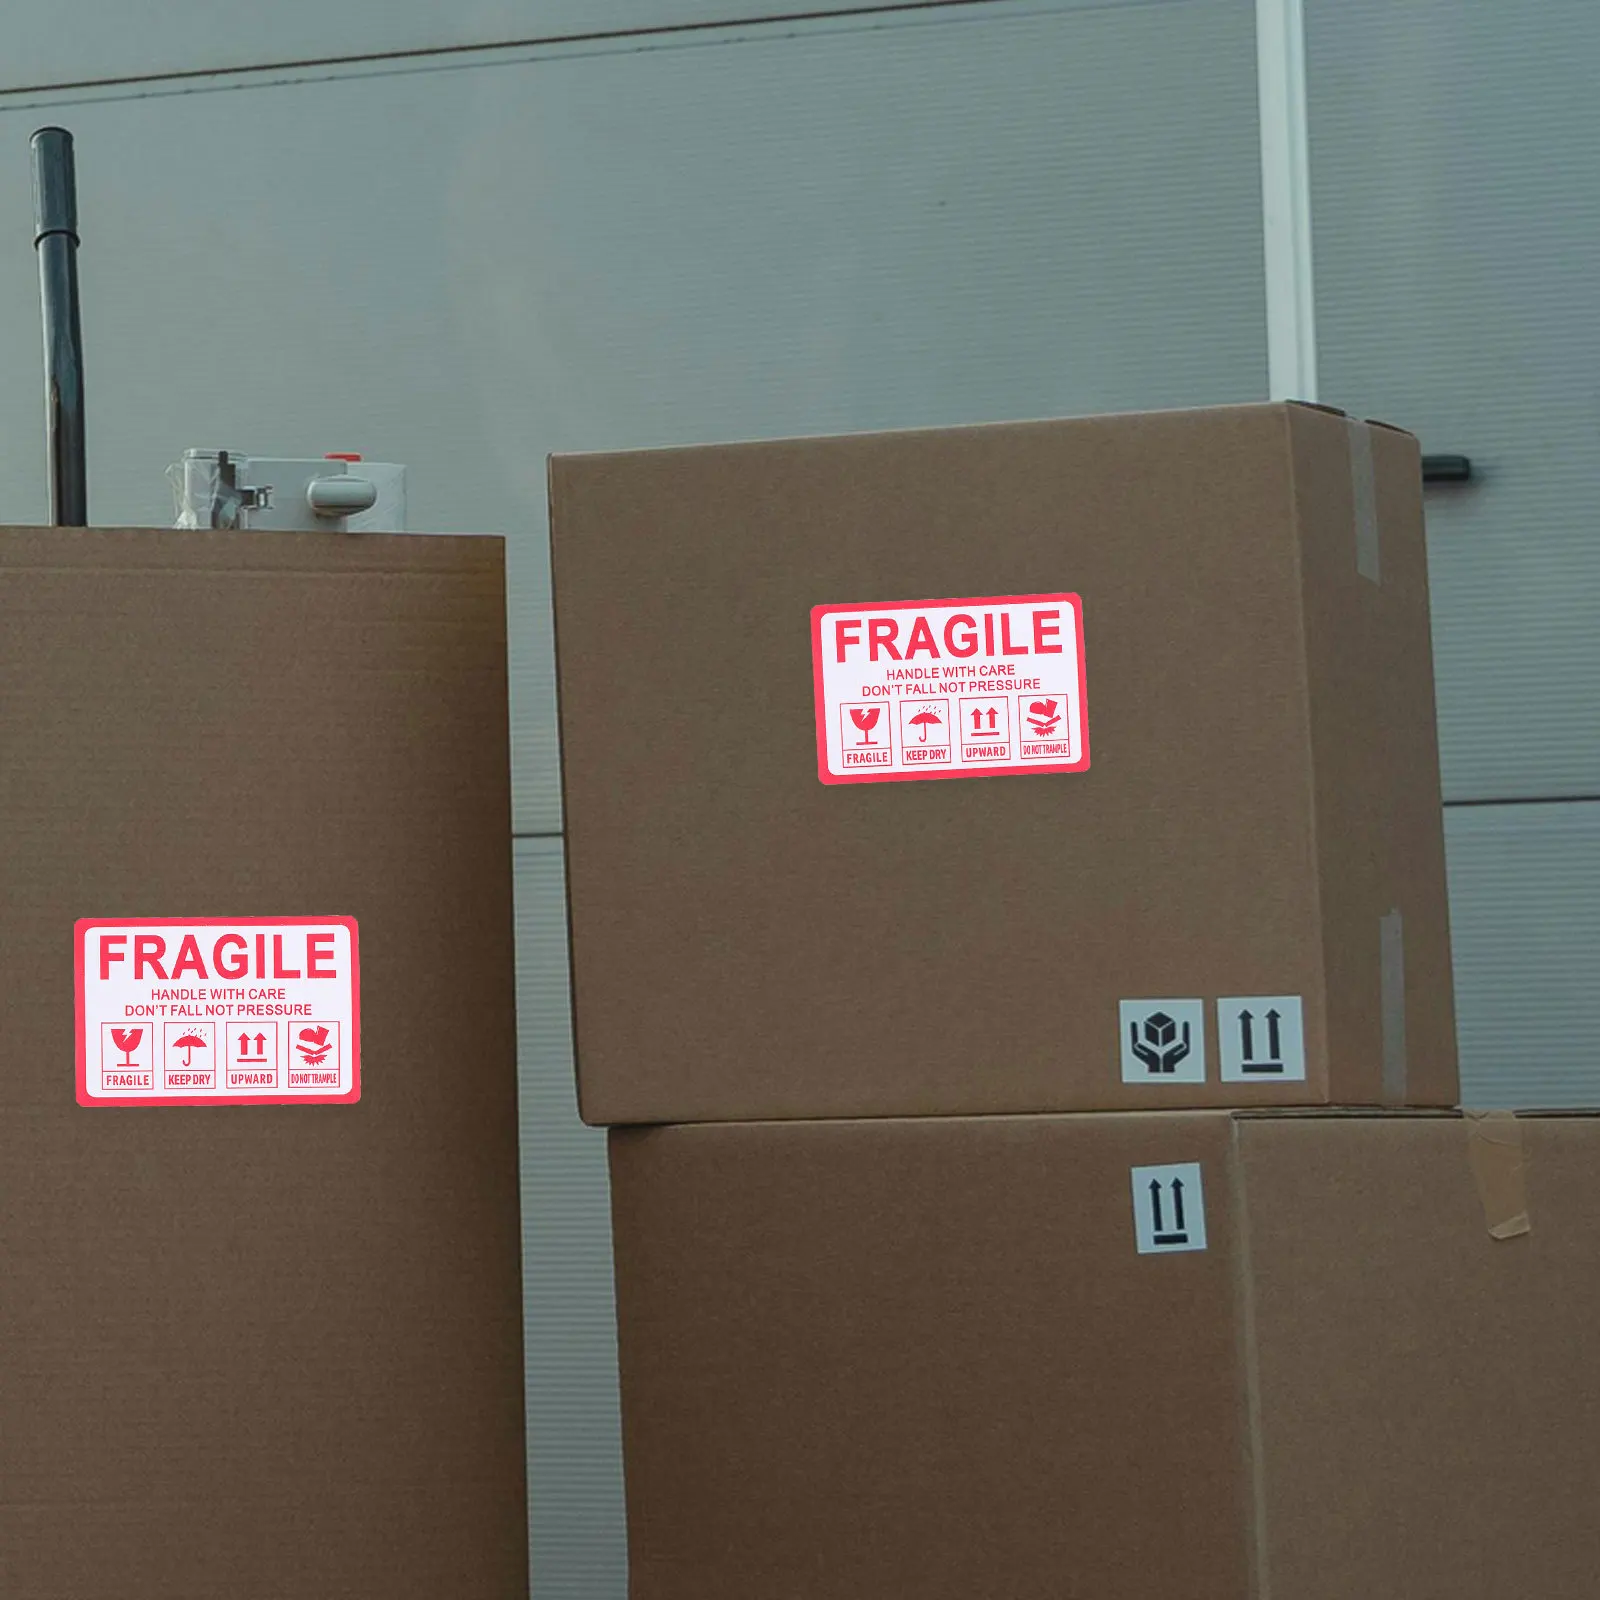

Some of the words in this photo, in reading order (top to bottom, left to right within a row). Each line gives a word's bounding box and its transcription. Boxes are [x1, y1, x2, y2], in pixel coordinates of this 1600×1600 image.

[836, 610, 1063, 663] FRAGILE
[887, 667, 939, 680] HANDLE
[942, 666, 975, 678] WITH
[979, 664, 1015, 676] CARE
[862, 684, 901, 696] DON'T
[906, 683, 936, 694] FALL
[939, 681, 968, 693] NOT
[970, 679, 1040, 692] PRESSURE
[906, 750, 929, 760] KEEP
[930, 749, 946, 759] DRY
[966, 746, 1006, 758] UPWARD
[1023, 745, 1031, 755] DO
[1032, 744, 1043, 754] NOT
[847, 752, 888, 763] FRAGILE
[100, 933, 336, 980] FRAGILE
[152, 989, 206, 1000] HANDLE
[210, 989, 245, 1000] WITH
[248, 988, 286, 1000] CARE
[125, 1005, 168, 1016] DON'T
[170, 1005, 203, 1016] FALL
[206, 1005, 234, 1016] NOT
[238, 1004, 312, 1016] PRESSURE
[106, 1074, 149, 1086] FRAGILE
[168, 1074, 192, 1085] KEEP
[192, 1074, 210, 1085] DRY
[231, 1074, 272, 1084] UPWARD
